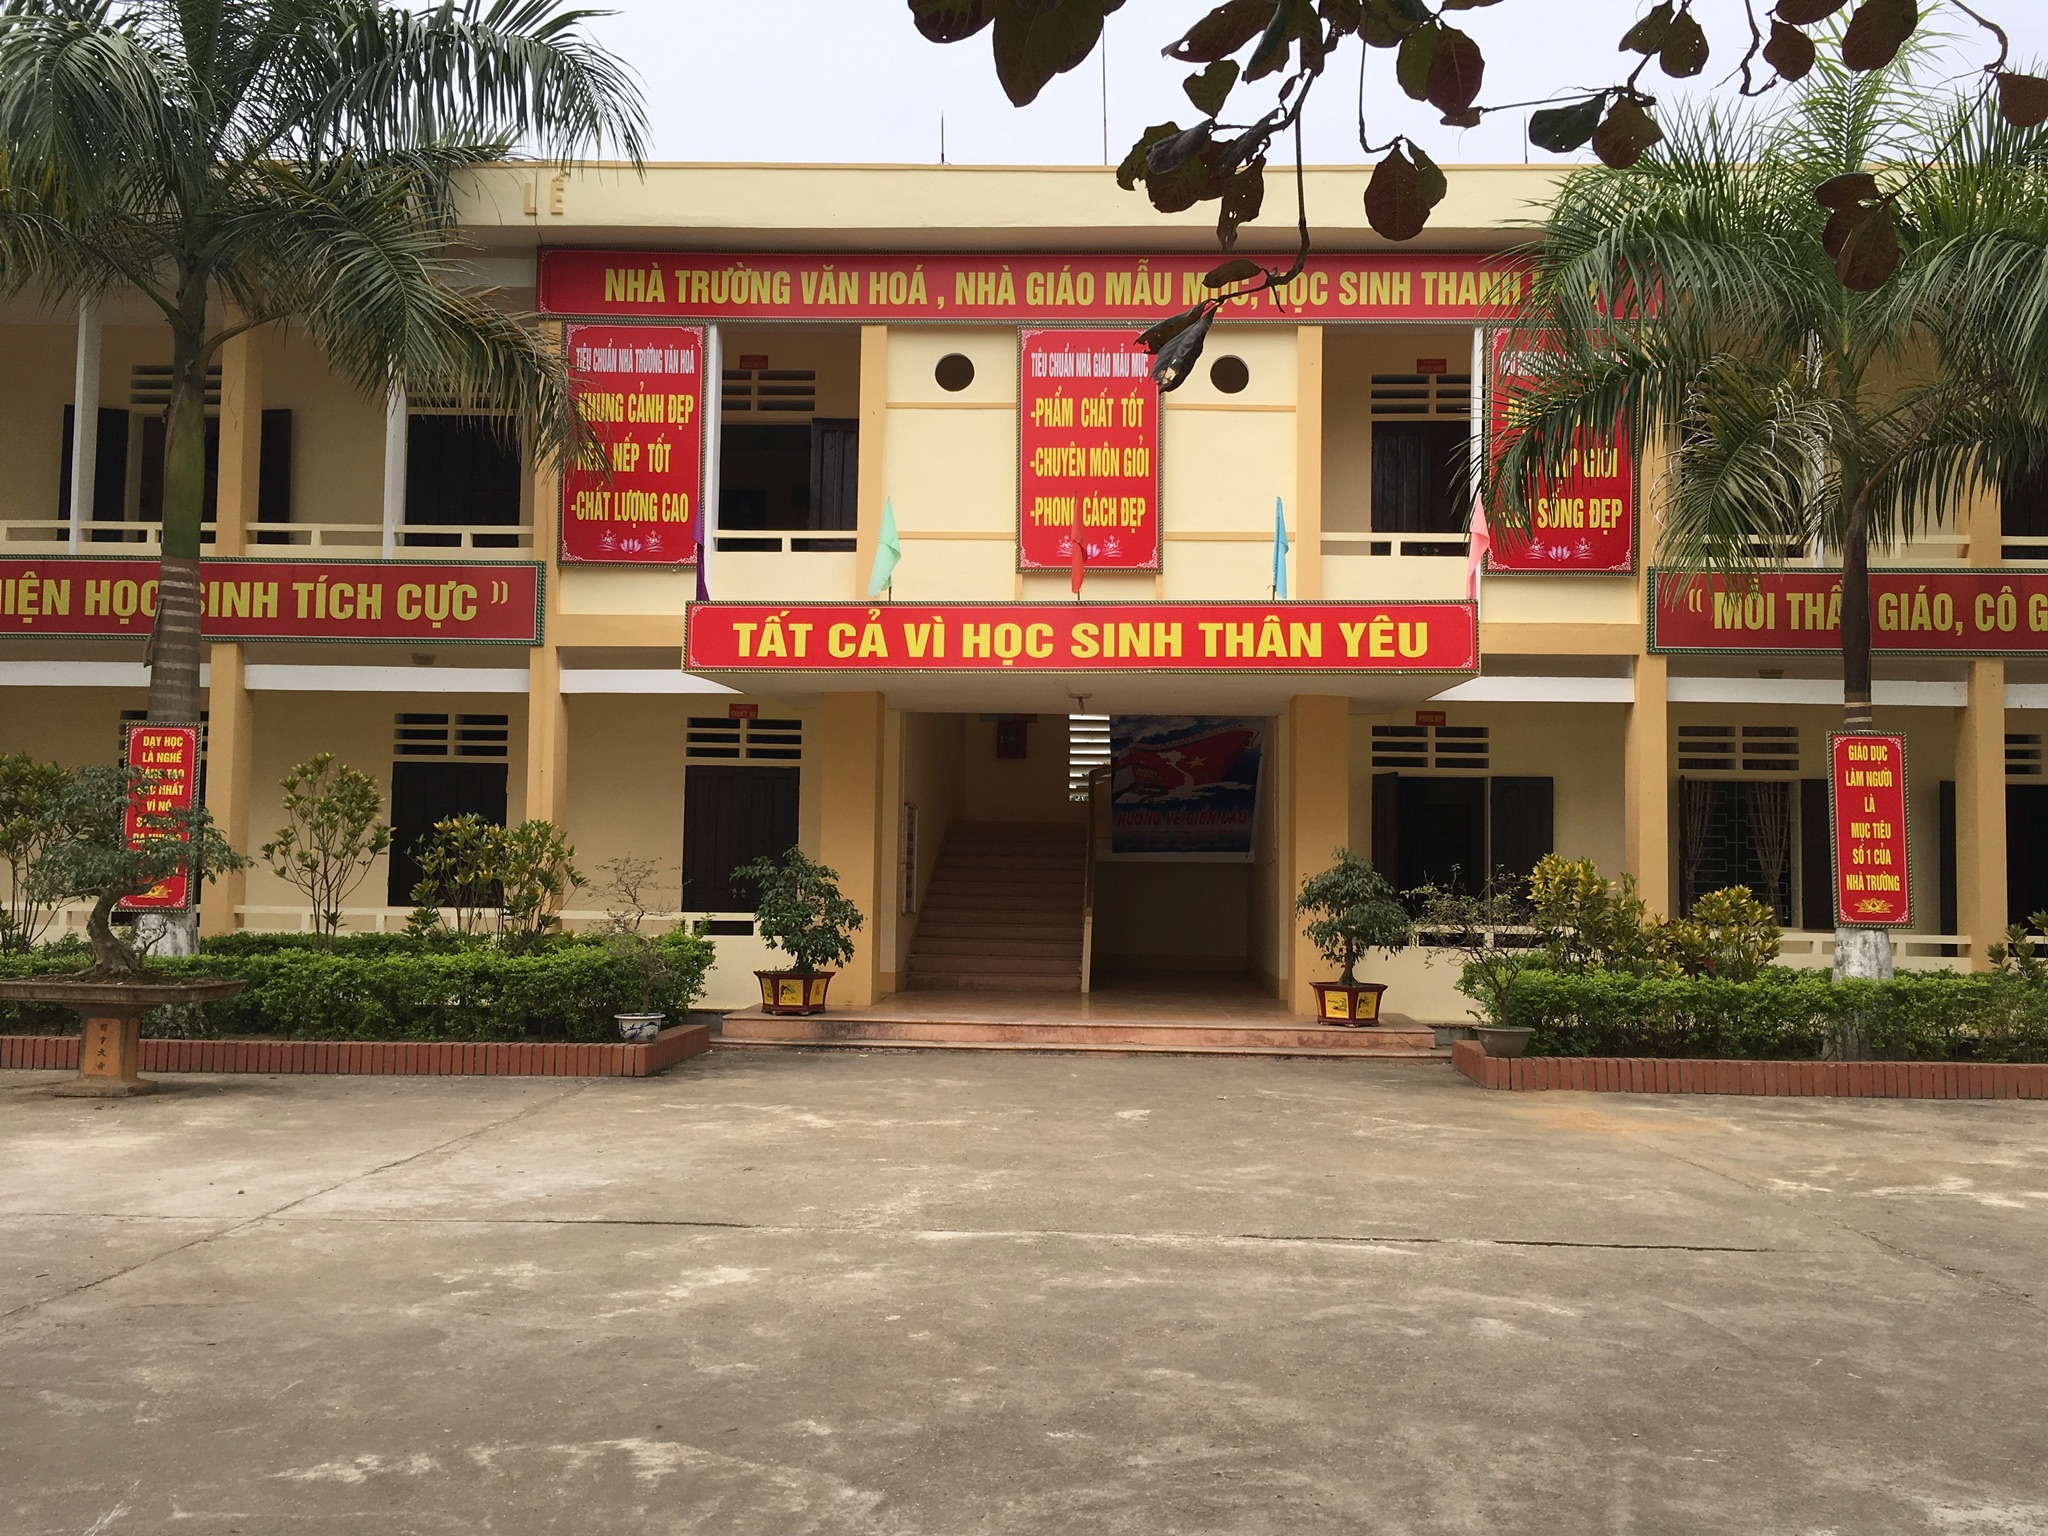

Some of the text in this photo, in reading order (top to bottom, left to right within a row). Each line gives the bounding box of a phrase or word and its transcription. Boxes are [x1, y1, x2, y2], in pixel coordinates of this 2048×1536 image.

[604, 262, 666, 303] NHÀ
[675, 261, 791, 305] TRƯỜNG
[800, 264, 859, 305] VĂN
[868, 264, 928, 305] HOÁ
[955, 264, 1017, 306] NHÀ
[1026, 264, 1095, 306] GIÁO
[1104, 258, 1172, 306] MẪU
[1338, 271, 1411, 306] SINH
[1420, 271, 1521, 306] THANH
[592, 338, 618, 373] CHUẨN
[618, 343, 634, 374] NHÀ
[634, 342, 663, 374] TRƯỜNG
[664, 344, 679, 374] VĂN
[680, 345, 695, 374] HOÁ
[1031, 347, 1048, 378] TIÊU
[1049, 343, 1075, 378] CHUẨN
[1076, 347, 1092, 378] NHÀ
[1093, 347, 1111, 378] GIÁO
[1112, 343, 1130, 378] MẪU
[628, 381, 665, 424] CẢNH
[668, 394, 694, 431] ĐẸP
[1030, 385, 1145, 428] -PHẨM CHẤT TỐT
[612, 433, 640, 473] NẾP
[648, 433, 672, 473] TỐT
[1030, 434, 1150, 478] -CHUYÊN MÔN GIỎI
[571, 481, 689, 529] -CHẤT LƯỢNG CAO
[1082, 490, 1117, 527] CÁCH
[1120, 497, 1146, 534] ĐẸP
[1588, 498, 1623, 536] ĐẸP
[0, 571, 71, 624] IỆN
[84, 579, 159, 625] HỌC
[200, 581, 279, 618] INH
[292, 575, 383, 620] TÍCH
[396, 580, 478, 629] CỰC
[1785, 579, 1843, 631] THẦ
[1878, 585, 1963, 636] GIÁO,
[1974, 585, 2017, 632] CÔ
[733, 609, 1430, 667] TẤT CẢ VÌ HỌC SINH THÂN YÊU
[142, 750, 154, 763] LÀ
[143, 736, 184, 749] DẠY HỌC
[1848, 742, 1888, 765] GIÁO DỤC
[159, 781, 185, 796] NHẤT
[1845, 767, 1893, 788] LÀM NGƯỜI
[146, 799, 173, 812] VÌ NÓ
[1864, 793, 1876, 813] LÀ
[1851, 820, 1891, 842] MỤC TIÊU
[1852, 843, 1892, 865] SỐ 1 CỦA
[1846, 871, 1901, 892] NHÀ TRƯỜNG
